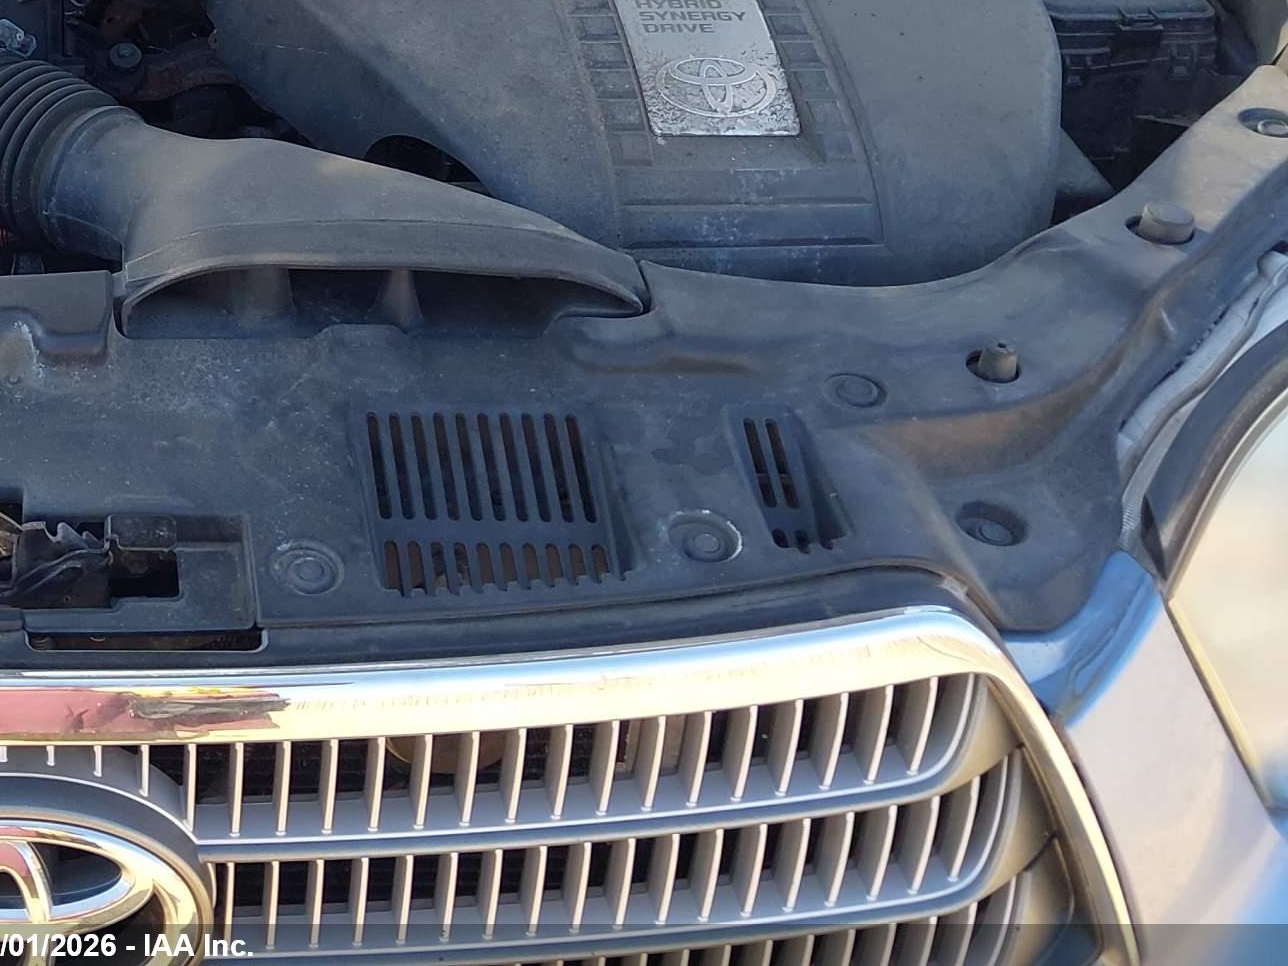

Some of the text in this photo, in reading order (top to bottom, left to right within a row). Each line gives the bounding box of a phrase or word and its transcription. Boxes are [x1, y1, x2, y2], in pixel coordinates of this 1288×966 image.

[634, 0, 723, 10] HYBRID
[639, 11, 747, 22] SYNERGY
[641, 23, 715, 33] DRIVE
